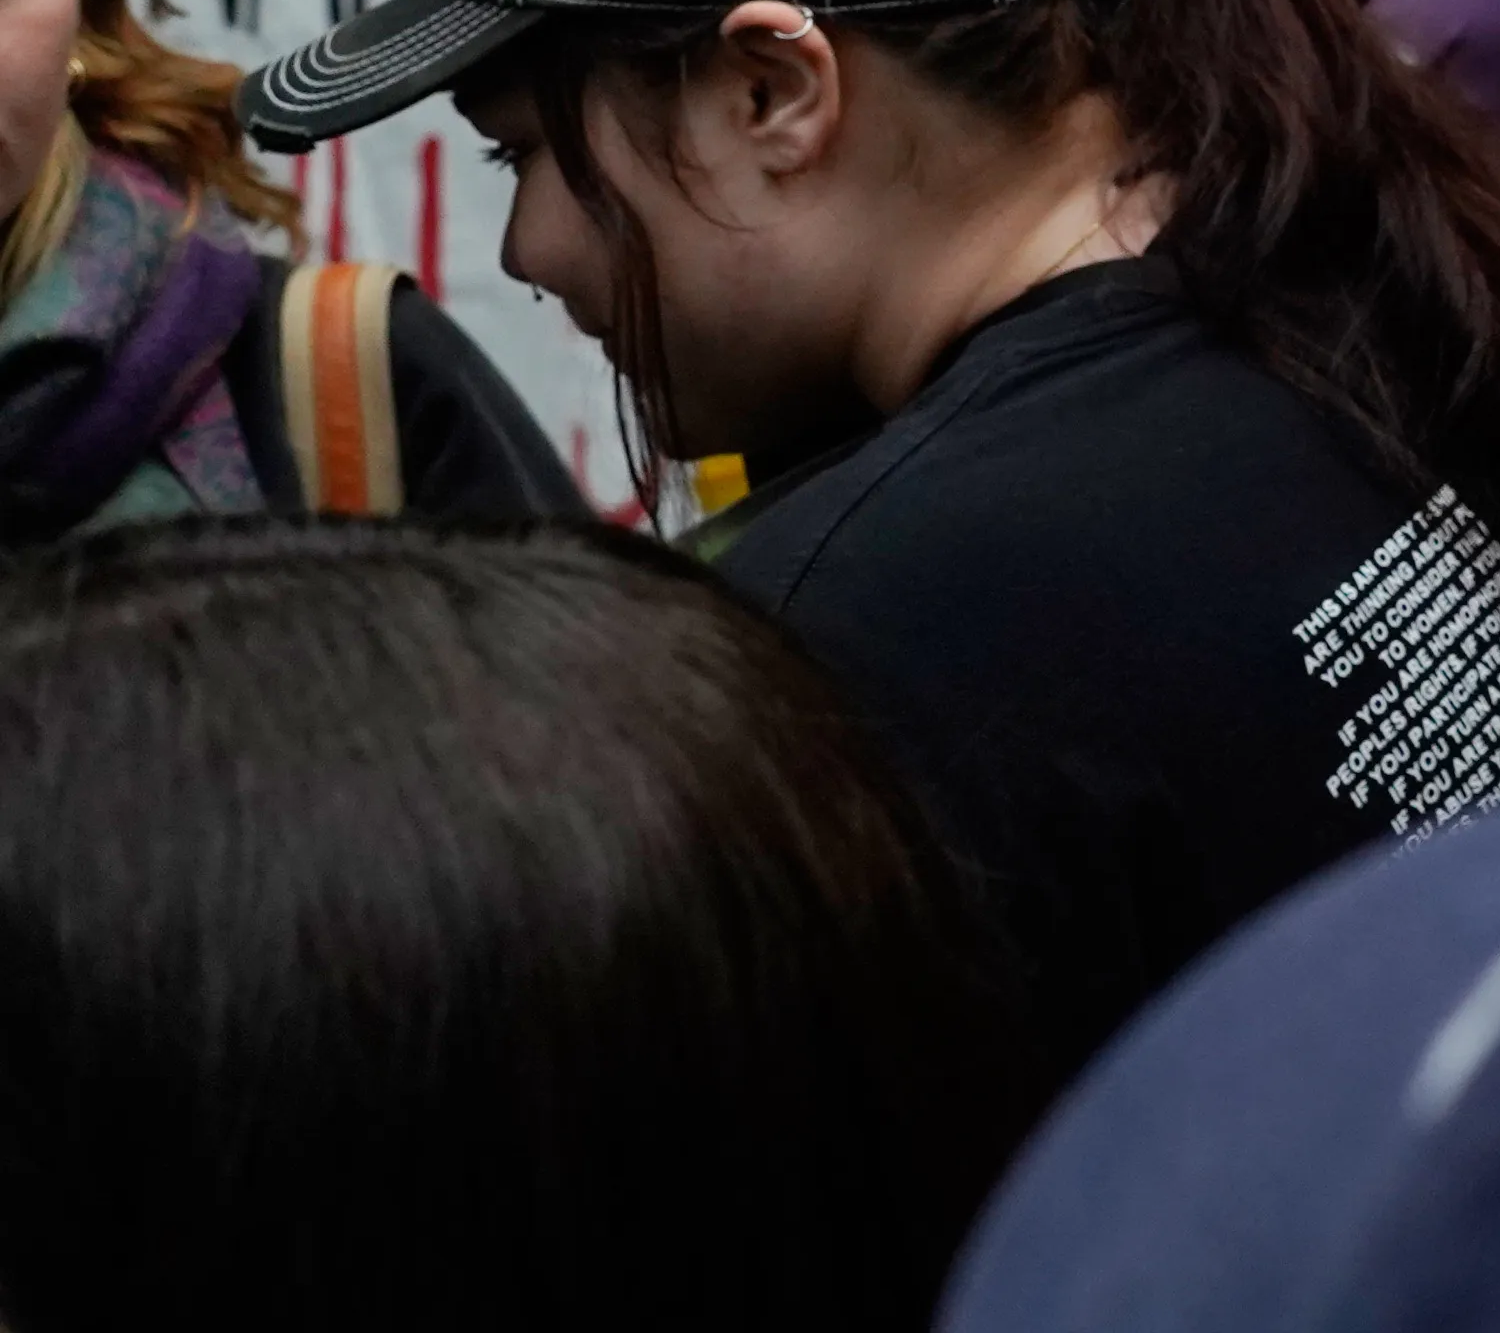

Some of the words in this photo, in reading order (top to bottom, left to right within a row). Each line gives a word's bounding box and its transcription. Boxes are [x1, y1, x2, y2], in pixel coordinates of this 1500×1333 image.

[1292, 598, 1341, 642] THIS
[1334, 582, 1358, 605] IS
[1352, 559, 1379, 590] AN
[1373, 520, 1417, 567] OBEY
[1303, 628, 1343, 674] ARE
[1340, 560, 1414, 635] THINKING
[1411, 517, 1457, 569] ABOUT
[1320, 642, 1364, 687] YOU
[1360, 621, 1388, 650] TO
[1385, 551, 1460, 627] CONSIDER
[1378, 639, 1406, 668] TO
[1458, 566, 1475, 590] IF
[1325, 709, 1415, 797] PEOPLES
[1460, 633, 1476, 659] IF
[1337, 718, 1356, 746] IF
[1355, 680, 1399, 724] YOU
[1398, 647, 1433, 690] ARE
[1387, 775, 1406, 803] IF
[1405, 736, 1449, 781] YOU
[1445, 694, 1491, 743] TURN
[1349, 779, 1368, 808] IF
[1368, 740, 1410, 784] YOU
[1390, 808, 1409, 835] IF
[1409, 768, 1451, 813] YOU
[1452, 733, 1488, 777] ARE
[1435, 762, 1494, 827] ABUSE
